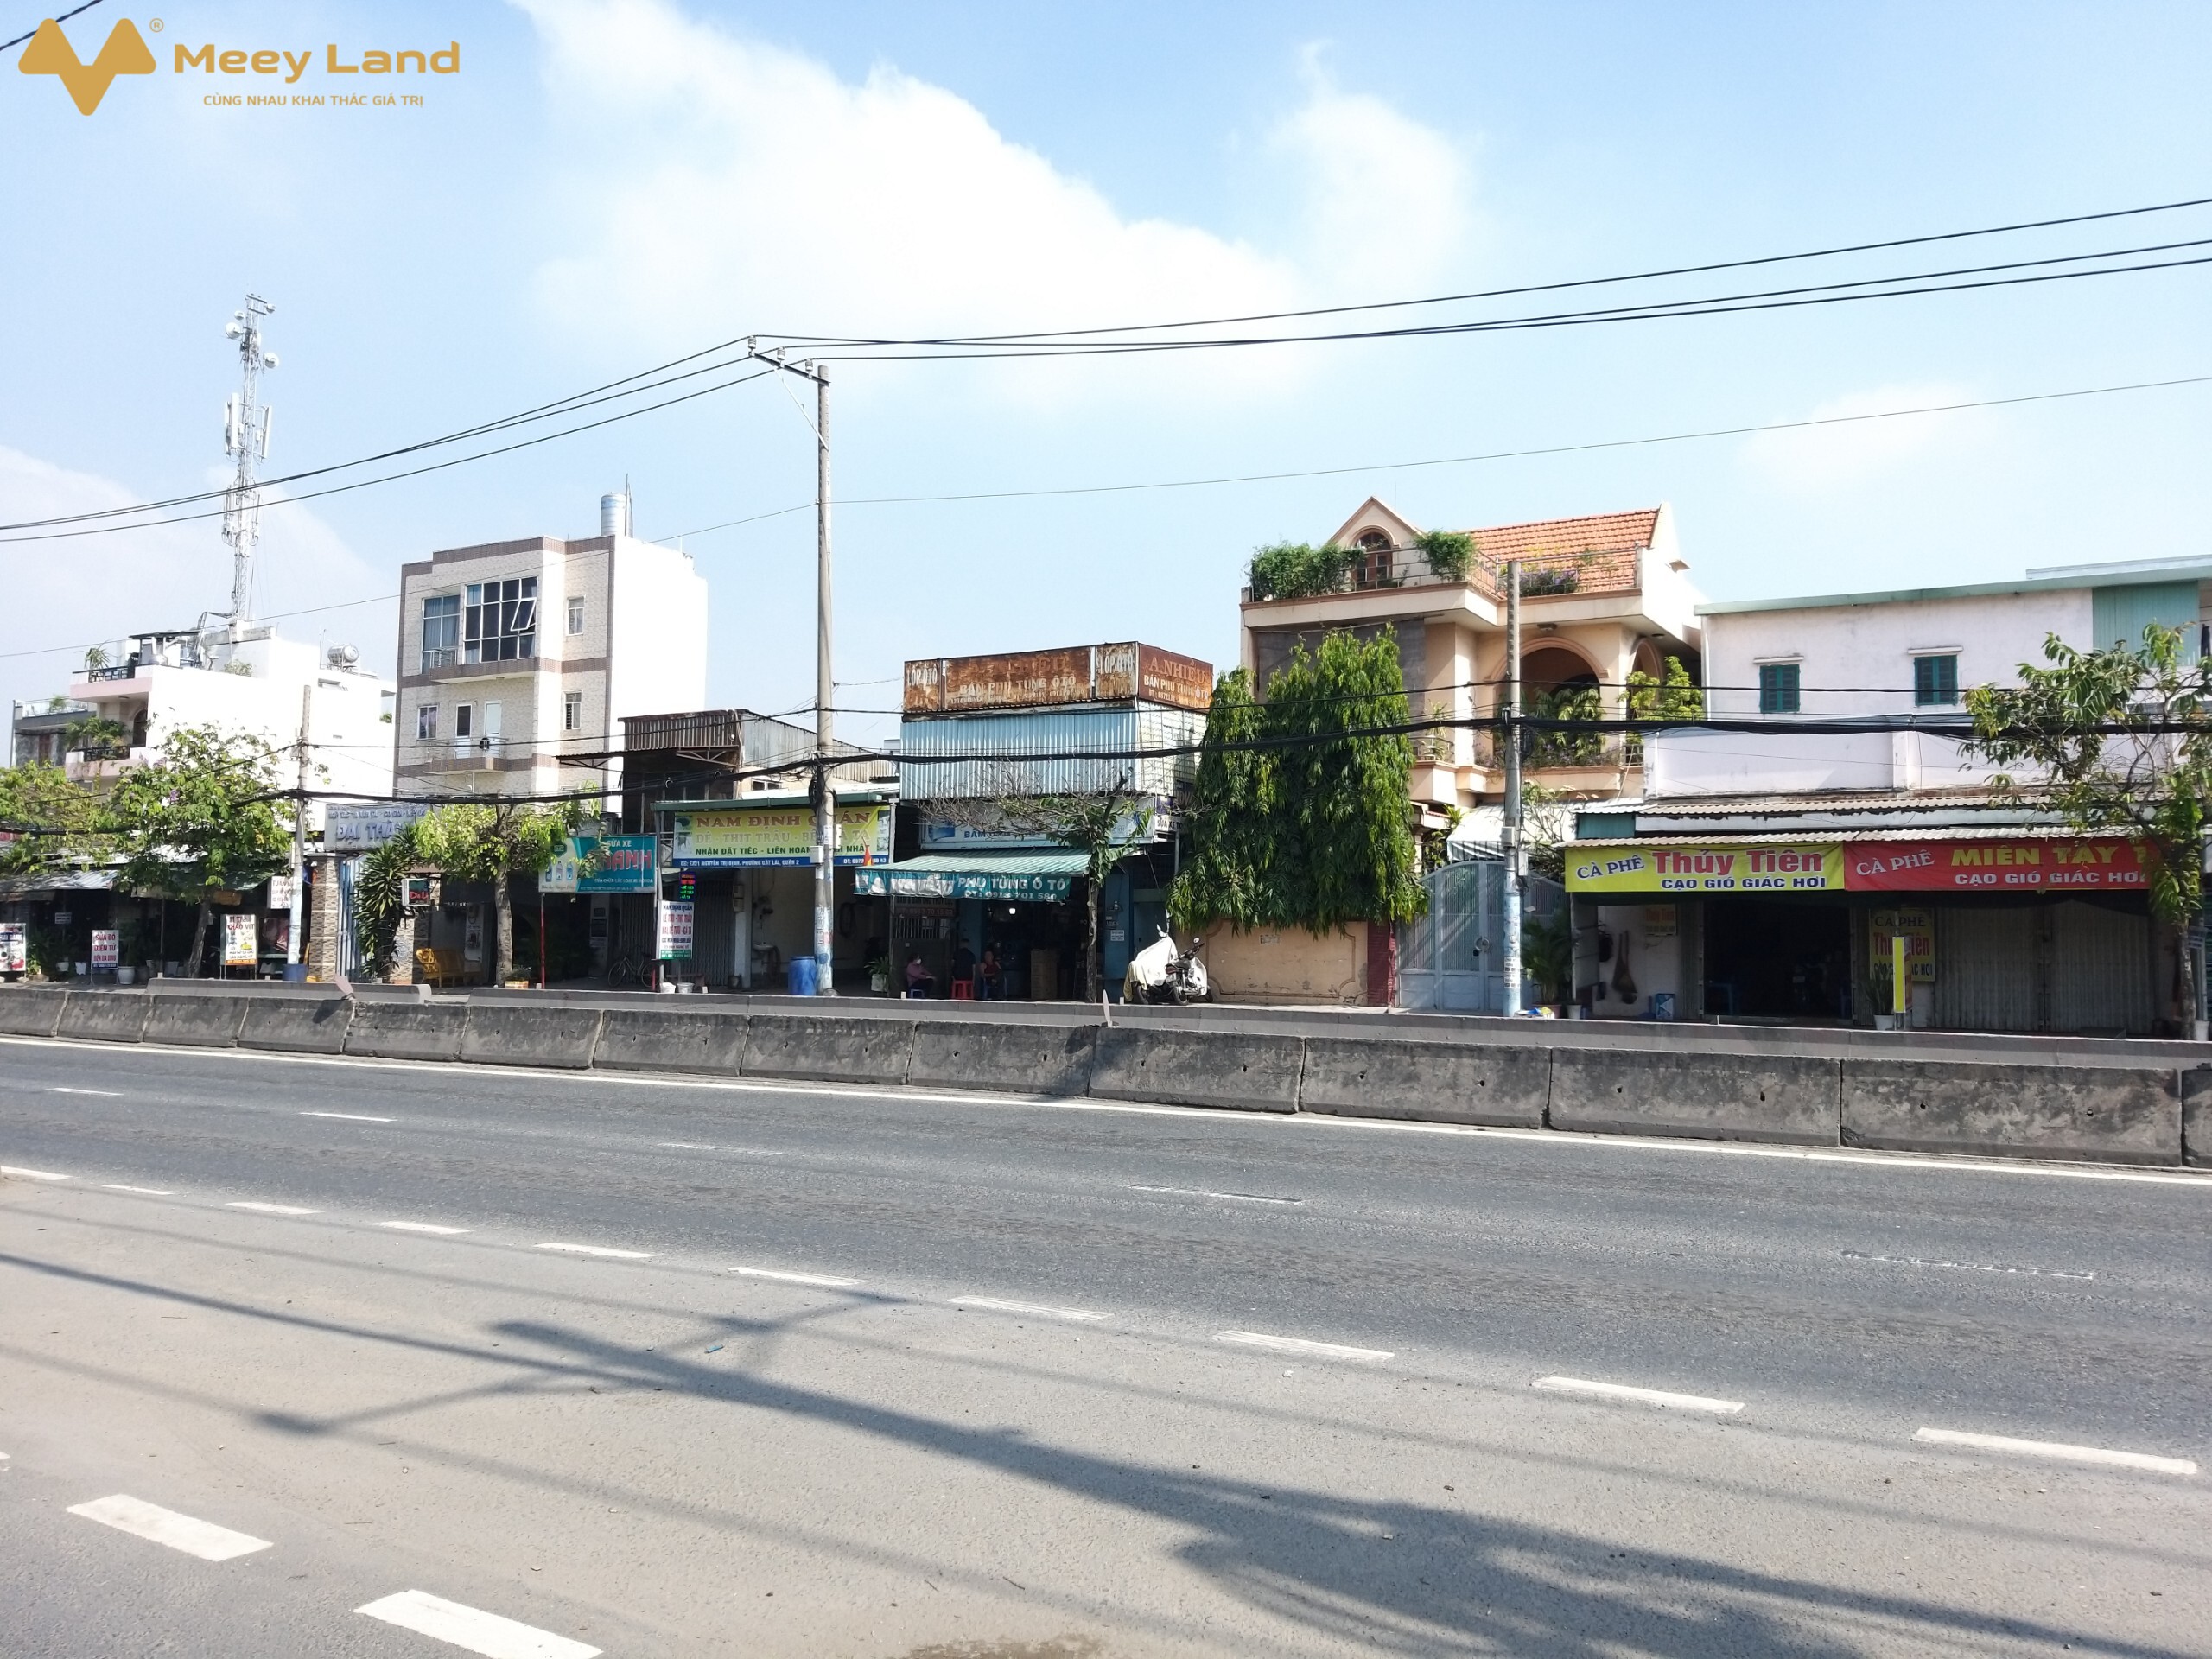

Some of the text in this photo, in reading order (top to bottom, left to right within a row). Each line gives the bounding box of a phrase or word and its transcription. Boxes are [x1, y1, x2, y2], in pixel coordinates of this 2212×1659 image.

[696, 810, 870, 830] NAM ĐỊNH QÁN
[336, 823, 361, 845] ĐẠI
[696, 847, 719, 857] NHẬN
[721, 847, 737, 857] ĐẶT
[740, 846, 758, 856] TIỆC
[766, 845, 786, 855] LIÊN
[1577, 849, 1823, 880] CÀ PHÊ Thủy Tiên
[1856, 855, 1887, 876] CÀ
[1891, 849, 1935, 871] PHÊ
[957, 873, 1066, 892] PHỤ TÙNG Ô TÔ
[1662, 875, 1826, 890] CẠO GIÓ GIÁC HƠI
[1955, 873, 1997, 886] CẠO
[2005, 871, 2041, 885] GIÓ
[2049, 871, 2101, 883] GIÁC
